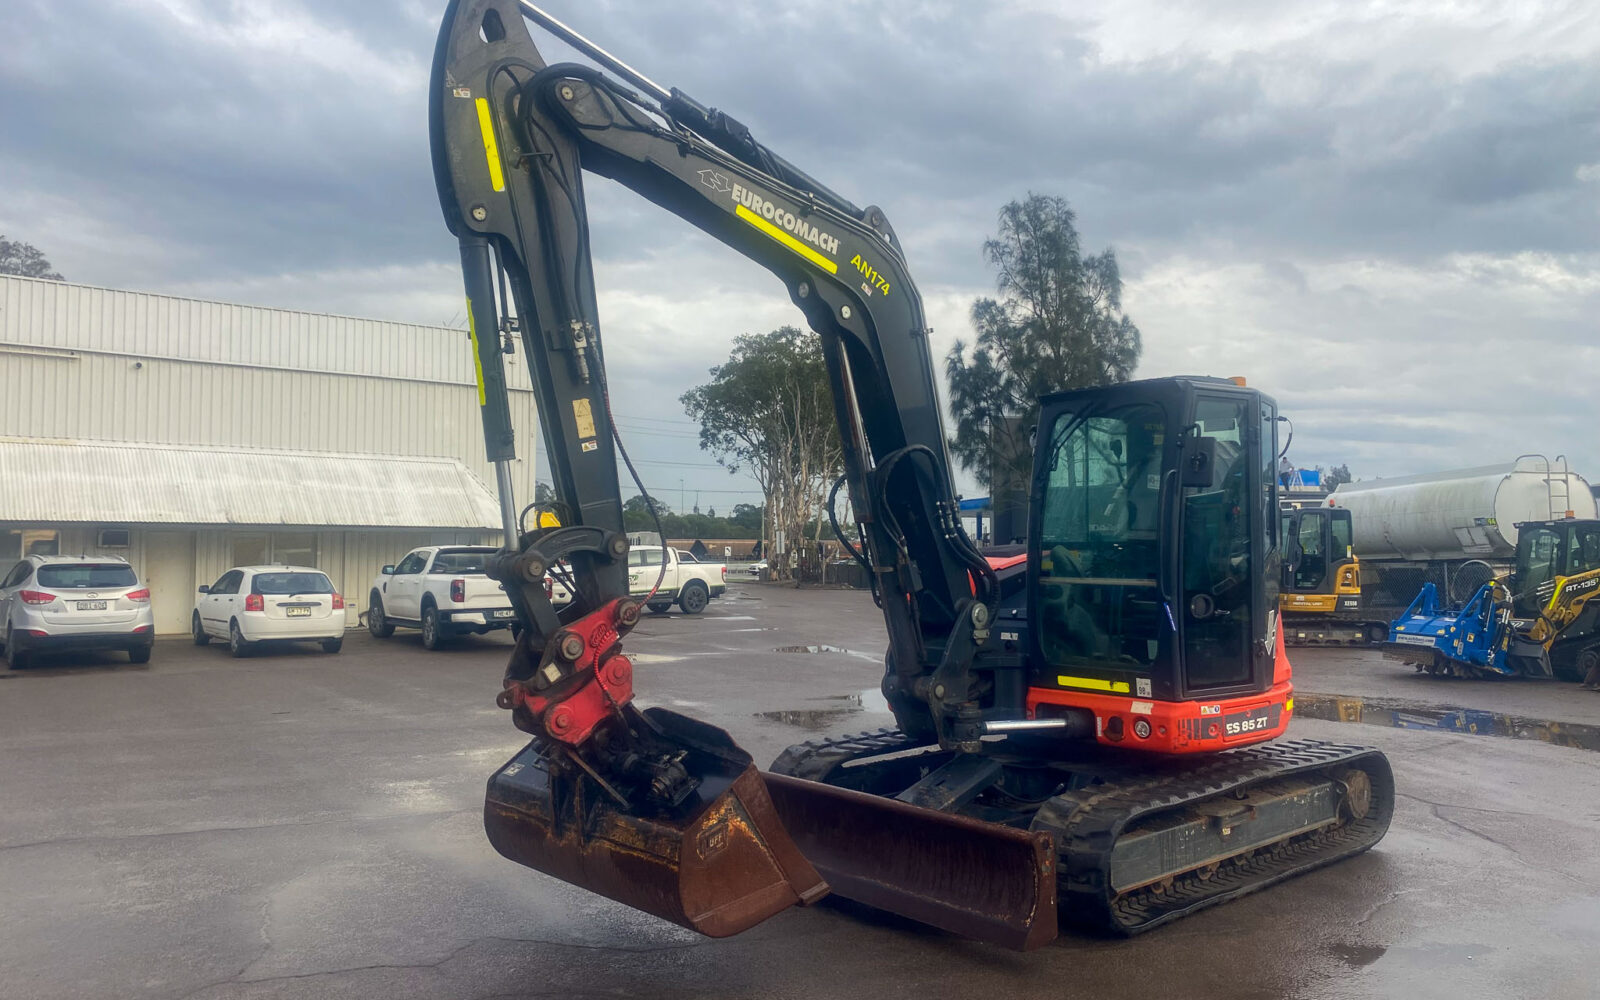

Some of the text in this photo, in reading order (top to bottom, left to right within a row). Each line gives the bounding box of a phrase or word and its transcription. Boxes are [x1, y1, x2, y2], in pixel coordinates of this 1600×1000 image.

[731, 183, 838, 256] EUROCOMACH
[850, 254, 891, 296] AN174
[1226, 716, 1268, 734] ES 85 ZT
